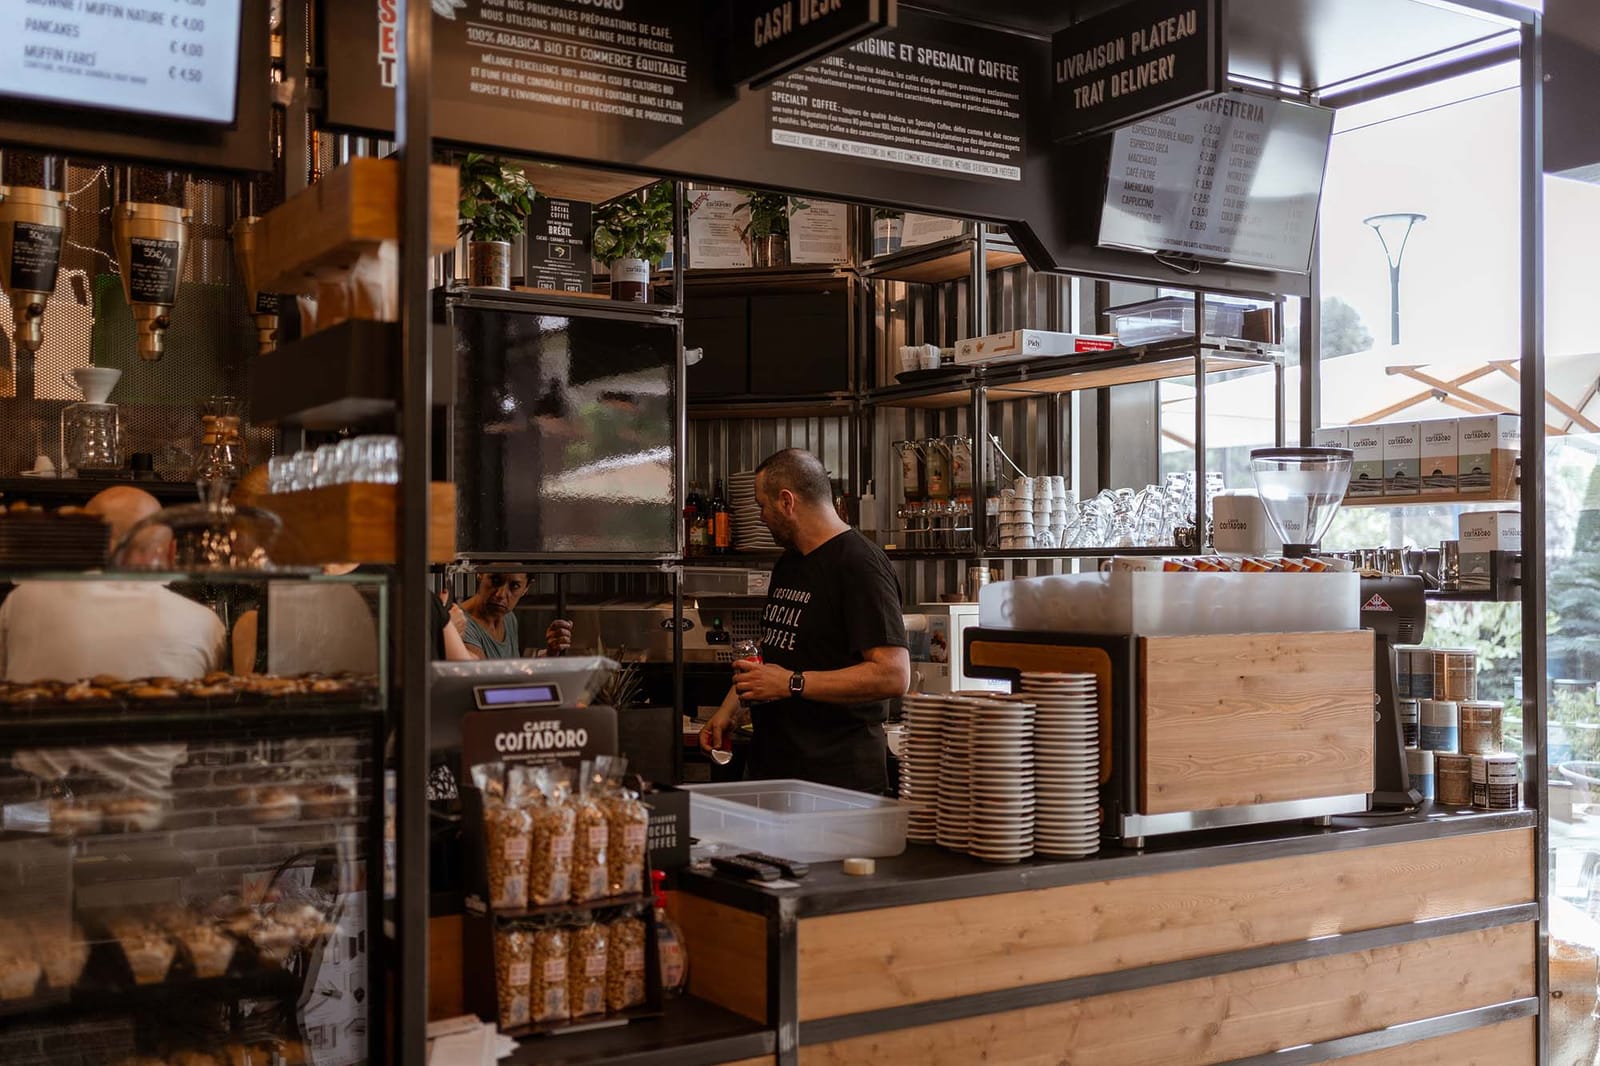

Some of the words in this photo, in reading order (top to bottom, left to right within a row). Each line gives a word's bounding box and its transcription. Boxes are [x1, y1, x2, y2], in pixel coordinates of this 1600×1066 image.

[85, 2, 124, 19] MUFFIN
[126, 7, 164, 26] NATURE
[507, 0, 525, 11] NOS
[527, 2, 578, 21] PRINCIPALES
[580, 12, 637, 32] PRÉPARATIONS
[639, 23, 649, 35] DE
[754, 1, 792, 48] CASH
[24, 17, 80, 38] PANCAKES
[480, 8, 504, 22] NOUS
[506, 13, 548, 30] UTILISONS
[550, 21, 576, 36] NOTRE
[578, 26, 617, 43] MÉLANGE
[617, 33, 637, 47] PLUS
[638, 37, 674, 53] PRÉCIEUX
[24, 44, 64, 61] MUFFIN
[466, 27, 496, 43] 100%
[496, 32, 541, 51] ARABICA
[544, 41, 562, 55] BIO
[565, 44, 578, 58] ET
[580, 47, 634, 68] COMMERCE
[636, 55, 687, 78] ÉQUITABLE
[1056, 37, 1125, 83] LIVRAISON
[1131, 9, 1197, 56] PLATEAU
[481, 53, 513, 68] MÉLANGE
[579, 70, 607, 83] ARABICA
[632, 79, 663, 93] CULTURES
[663, 84, 674, 95] BIO
[899, 43, 912, 62] ET
[917, 47, 974, 74] SPECIALTY
[978, 59, 1019, 82] COFFEE
[471, 66, 480, 77] ET
[639, 94, 657, 107] DANS
[657, 98, 665, 108] LE
[1073, 79, 1105, 109] TRAY
[1111, 54, 1176, 98] DELIVERY
[470, 81, 500, 95] RESPECT
[500, 86, 510, 97] DE
[635, 108, 644, 119] DE
[772, 91, 807, 107] SPECIALTY
[811, 96, 840, 112] COFFEE:
[1123, 180, 1154, 195] AMERICANO
[551, 205, 569, 213] SOCIAL
[1121, 194, 1154, 209] CAPPUCCINO
[551, 212, 569, 220] COFFEE
[549, 225, 571, 236] BRÉSIL
[1220, 522, 1247, 530] COSTADORO
[773, 587, 811, 604] COSTADORO
[763, 603, 802, 627] SOCIAL
[495, 728, 588, 752] COSTADORO
[649, 824, 676, 837] OCIAL
[649, 836, 677, 850] OFFEE
